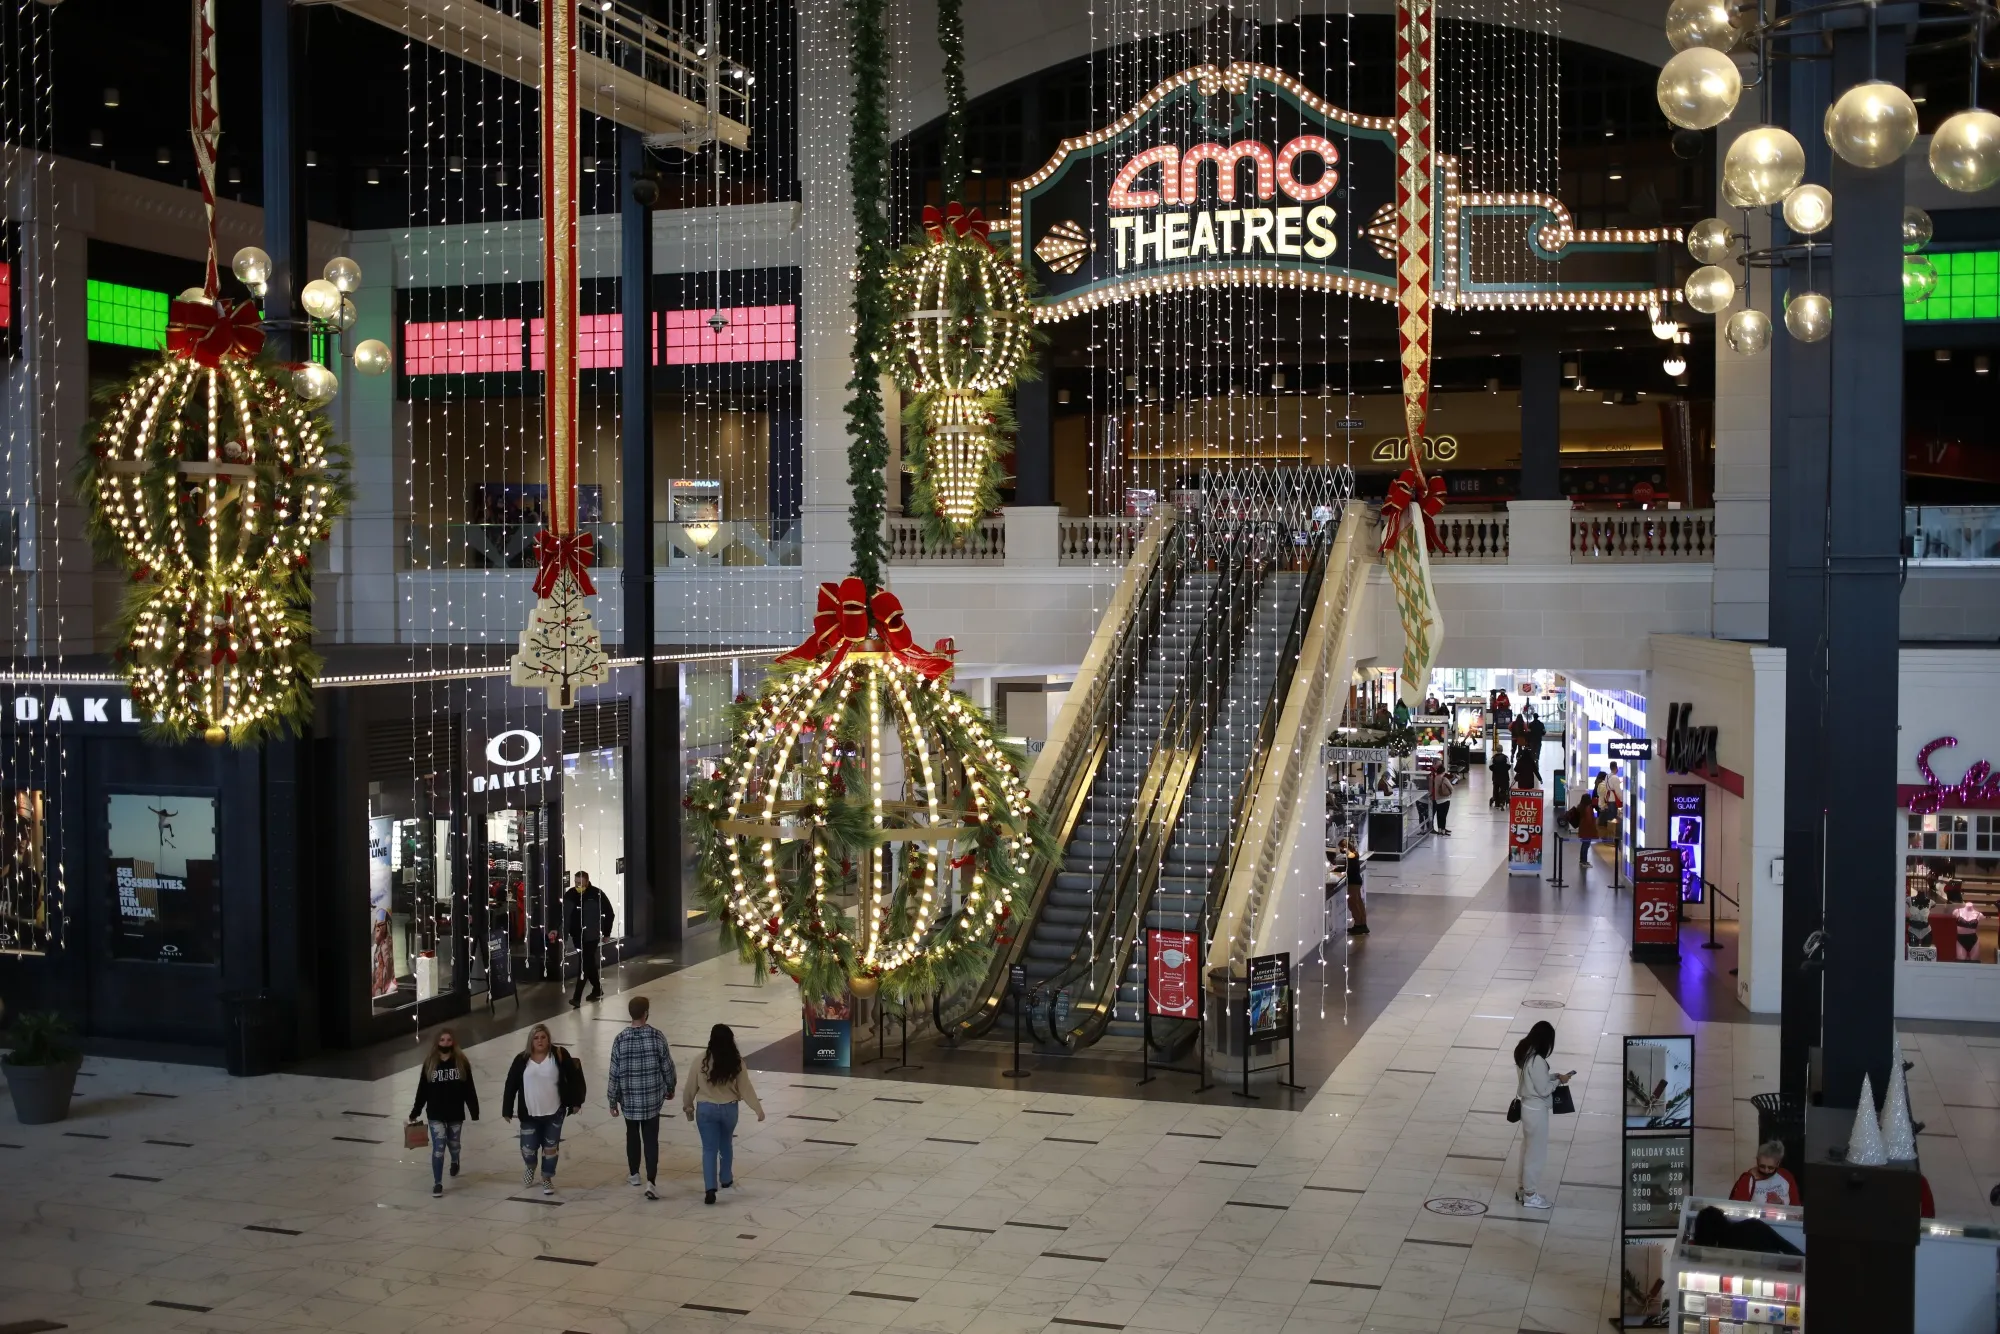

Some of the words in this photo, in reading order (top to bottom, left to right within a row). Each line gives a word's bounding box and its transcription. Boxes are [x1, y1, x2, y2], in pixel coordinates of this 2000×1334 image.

[1109, 135, 1339, 209] amc
[1110, 205, 1337, 269] THEATRES
[1605, 443, 1632, 451] CANDY
[1610, 742, 1626, 750] Bath
[1626, 742, 1632, 750] &
[1632, 742, 1649, 751] Body
[1326, 748, 1347, 761] GUEST
[1351, 749, 1383, 762] SERVICES
[472, 765, 554, 793] OAKLEY
[1516, 801, 1537, 811] ALL
[1514, 816, 1537, 824] CARE
[371, 847, 388, 858] LINE
[117, 867, 133, 877] SEE
[1640, 863, 1649, 873] 5
[117, 877, 186, 890] POSSIBILITIES.
[119, 887, 135, 897] SEE
[120, 897, 129, 906] IT
[129, 898, 140, 908] IN
[1631, 1147, 1663, 1157] HOLIDAY
[1665, 1146, 1685, 1156] SALE
[1632, 1173, 1651, 1182] $100
[1668, 1172, 1683, 1181] $20
[1632, 1188, 1651, 1197] $200
[1668, 1187, 1683, 1196] $50
[1632, 1203, 1651, 1212] $300
[1668, 1202, 1682, 1211] $75
